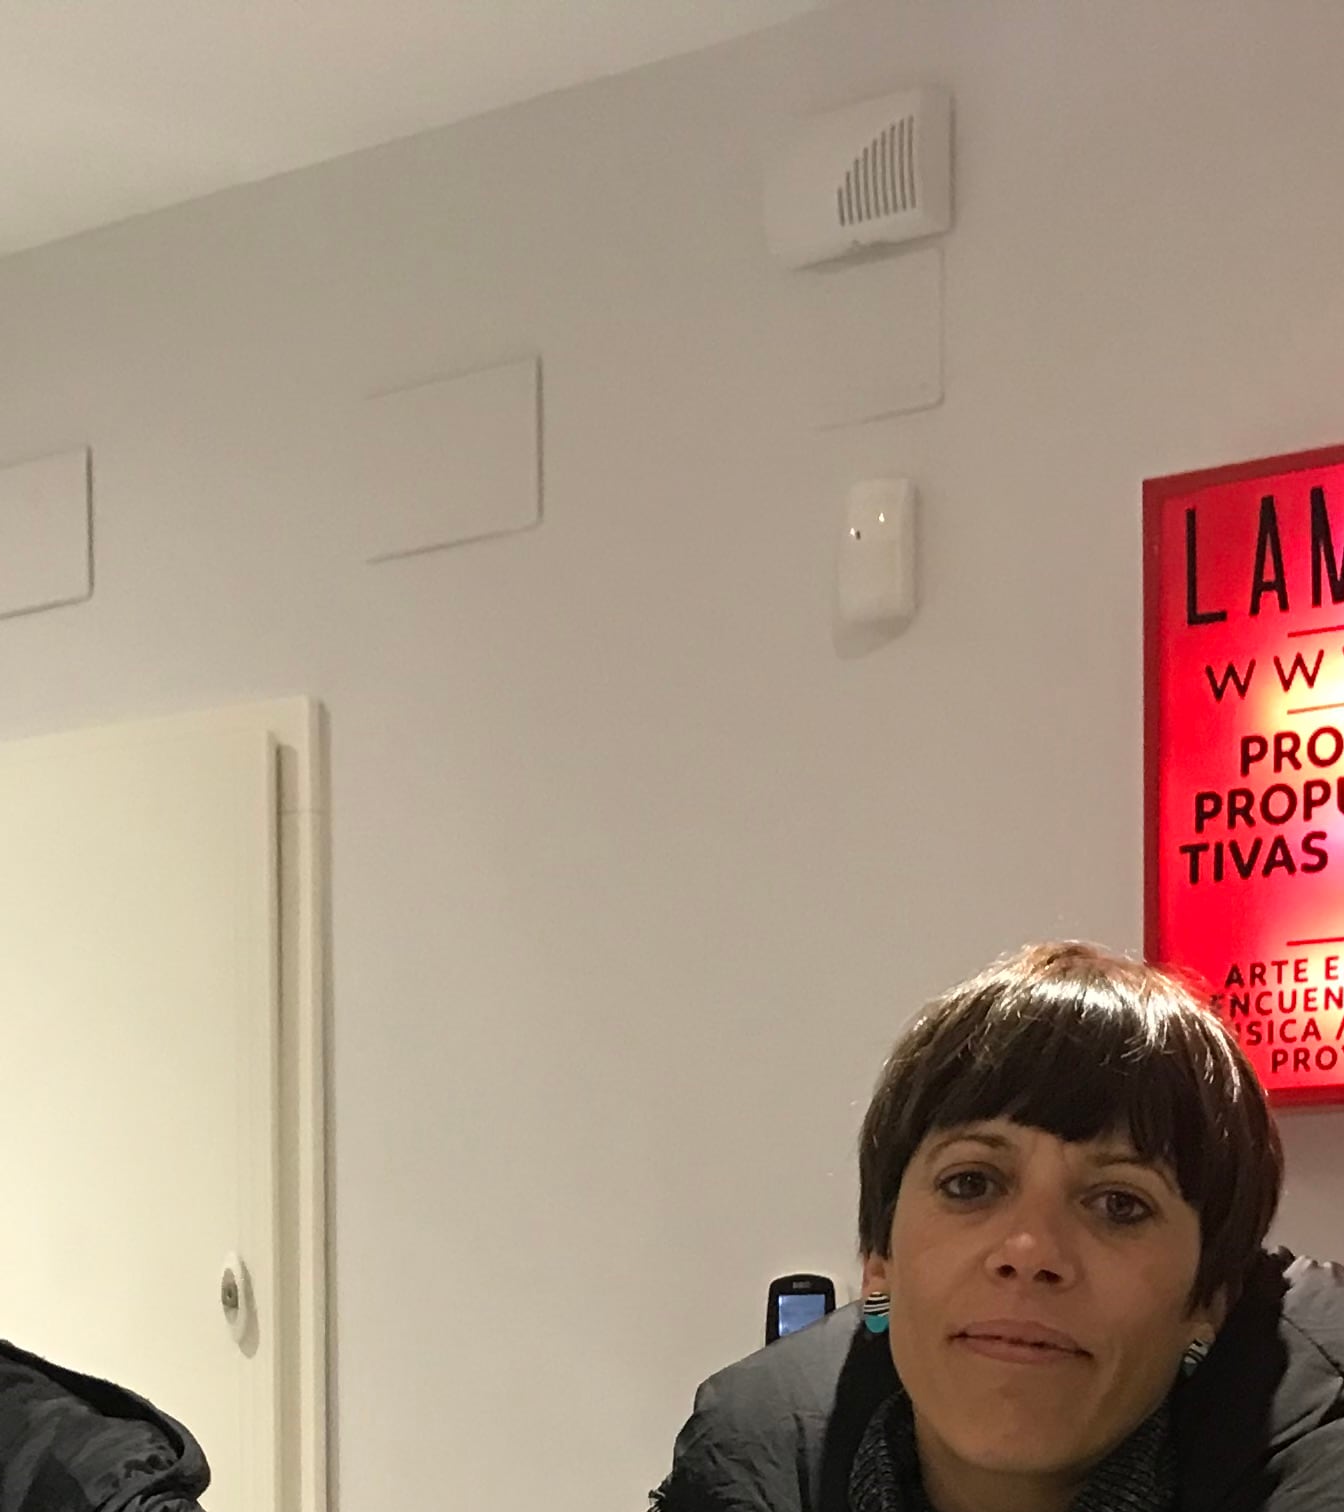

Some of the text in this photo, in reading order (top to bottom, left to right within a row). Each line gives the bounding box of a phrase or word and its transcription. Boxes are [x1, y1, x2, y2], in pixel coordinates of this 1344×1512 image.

[1179, 831, 1328, 884] TIVAS
[1225, 959, 1308, 988] ARTE
[1236, 1017, 1321, 1046] SICA
